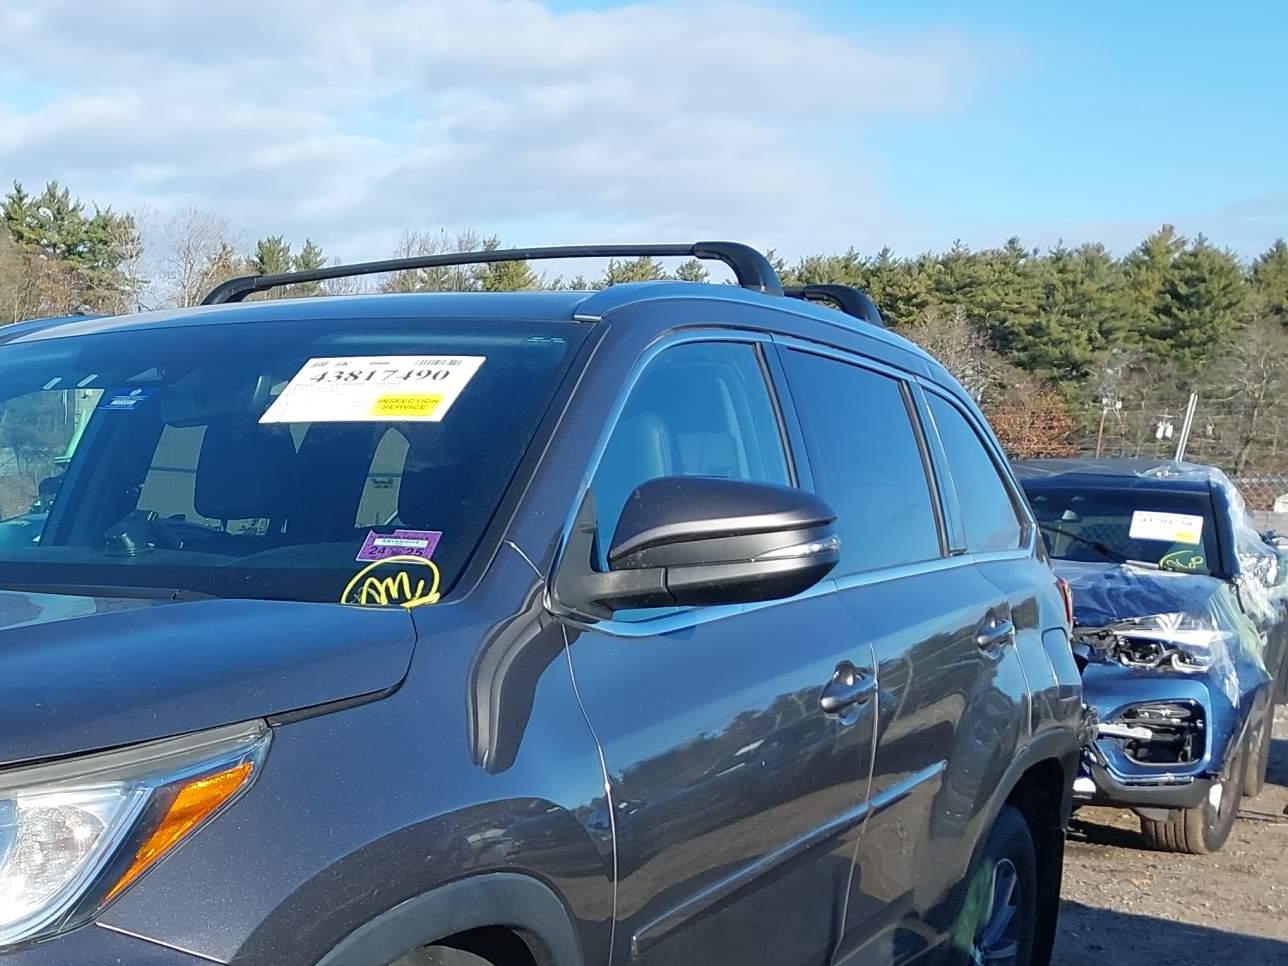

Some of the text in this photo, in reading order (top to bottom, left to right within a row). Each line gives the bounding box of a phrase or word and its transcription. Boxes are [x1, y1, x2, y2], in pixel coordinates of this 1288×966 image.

[310, 369, 450, 382] 43817490
[368, 546, 425, 556] 24 25
